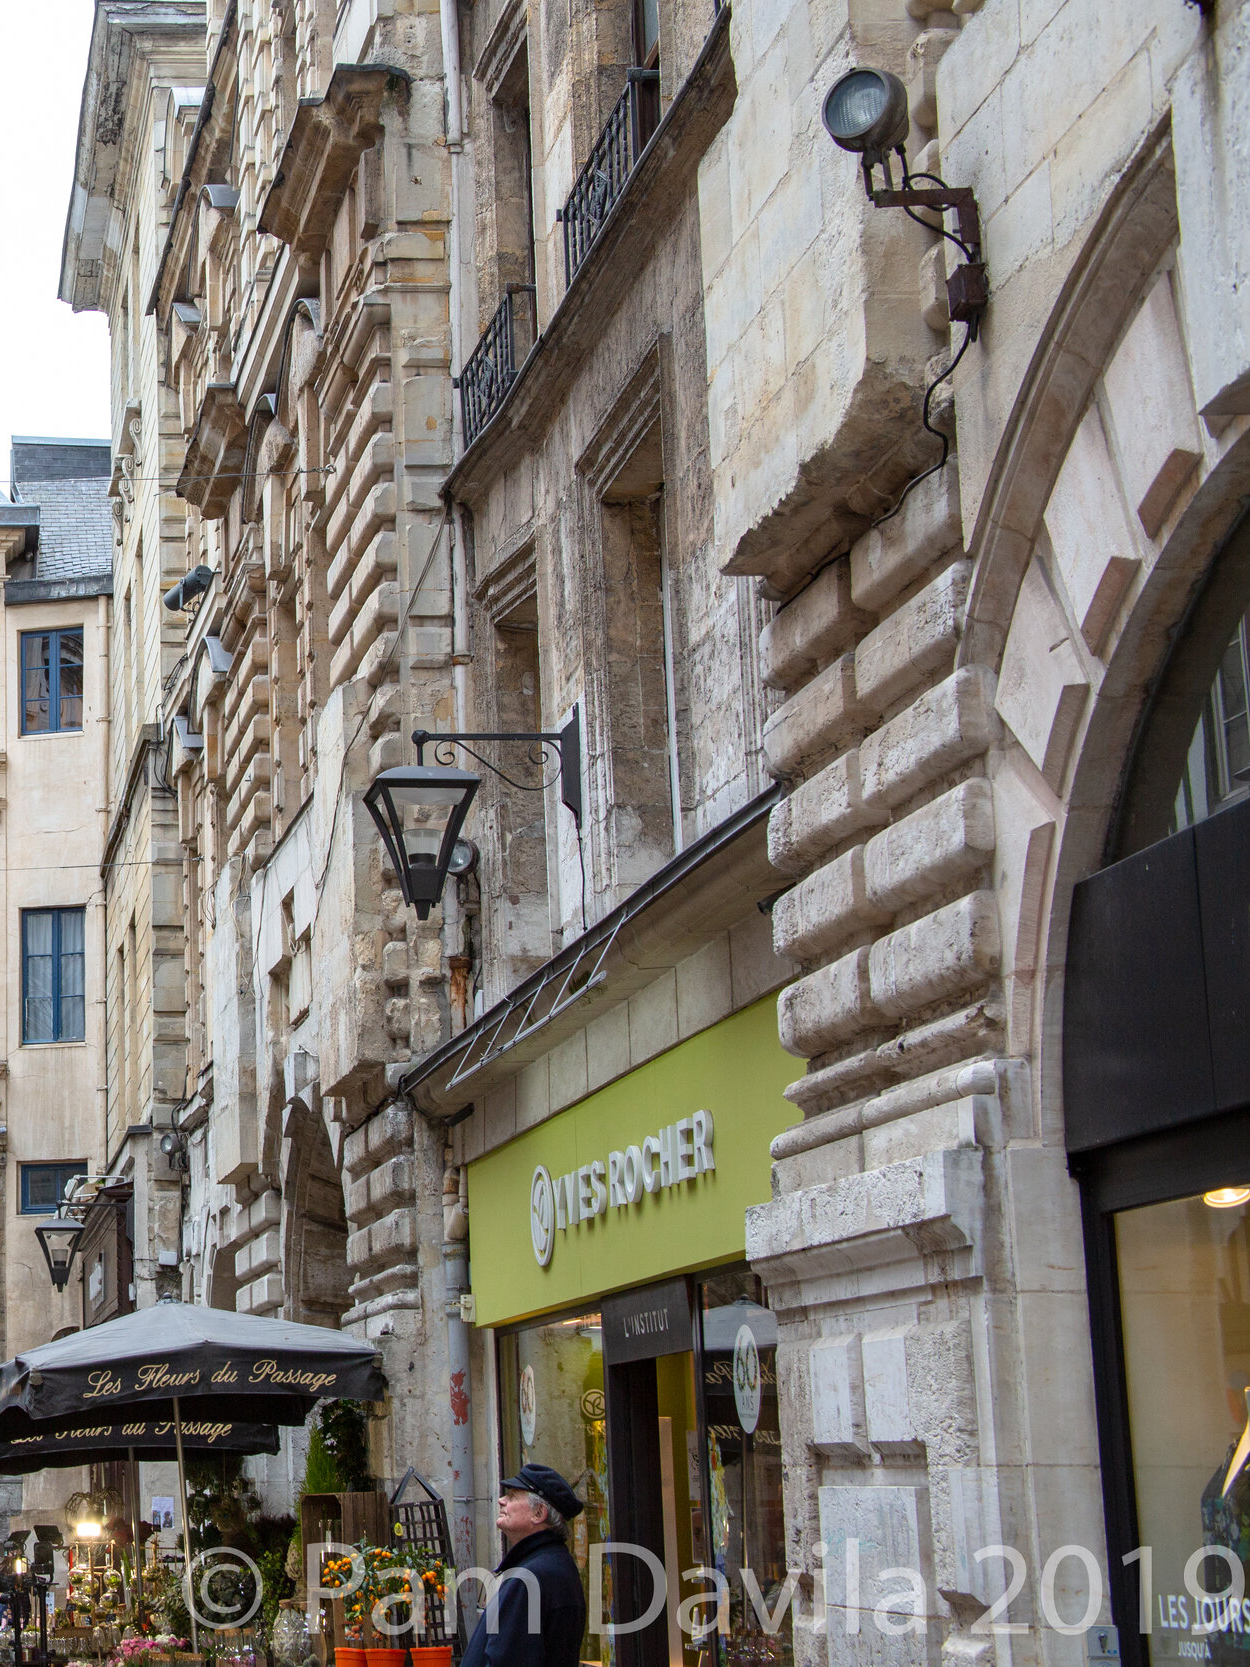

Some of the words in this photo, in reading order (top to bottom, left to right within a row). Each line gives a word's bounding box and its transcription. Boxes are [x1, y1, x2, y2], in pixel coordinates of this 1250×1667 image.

[552, 1160, 607, 1230] YVES
[608, 1109, 716, 1208] ROCHER
[623, 1308, 669, 1338] L'INSTITUT
[83, 1370, 121, 1398] Les
[134, 1363, 200, 1391] Fleurs
[211, 1361, 238, 1383] du
[248, 1359, 337, 1388] Passage
[1158, 1594, 1190, 1629] LES
